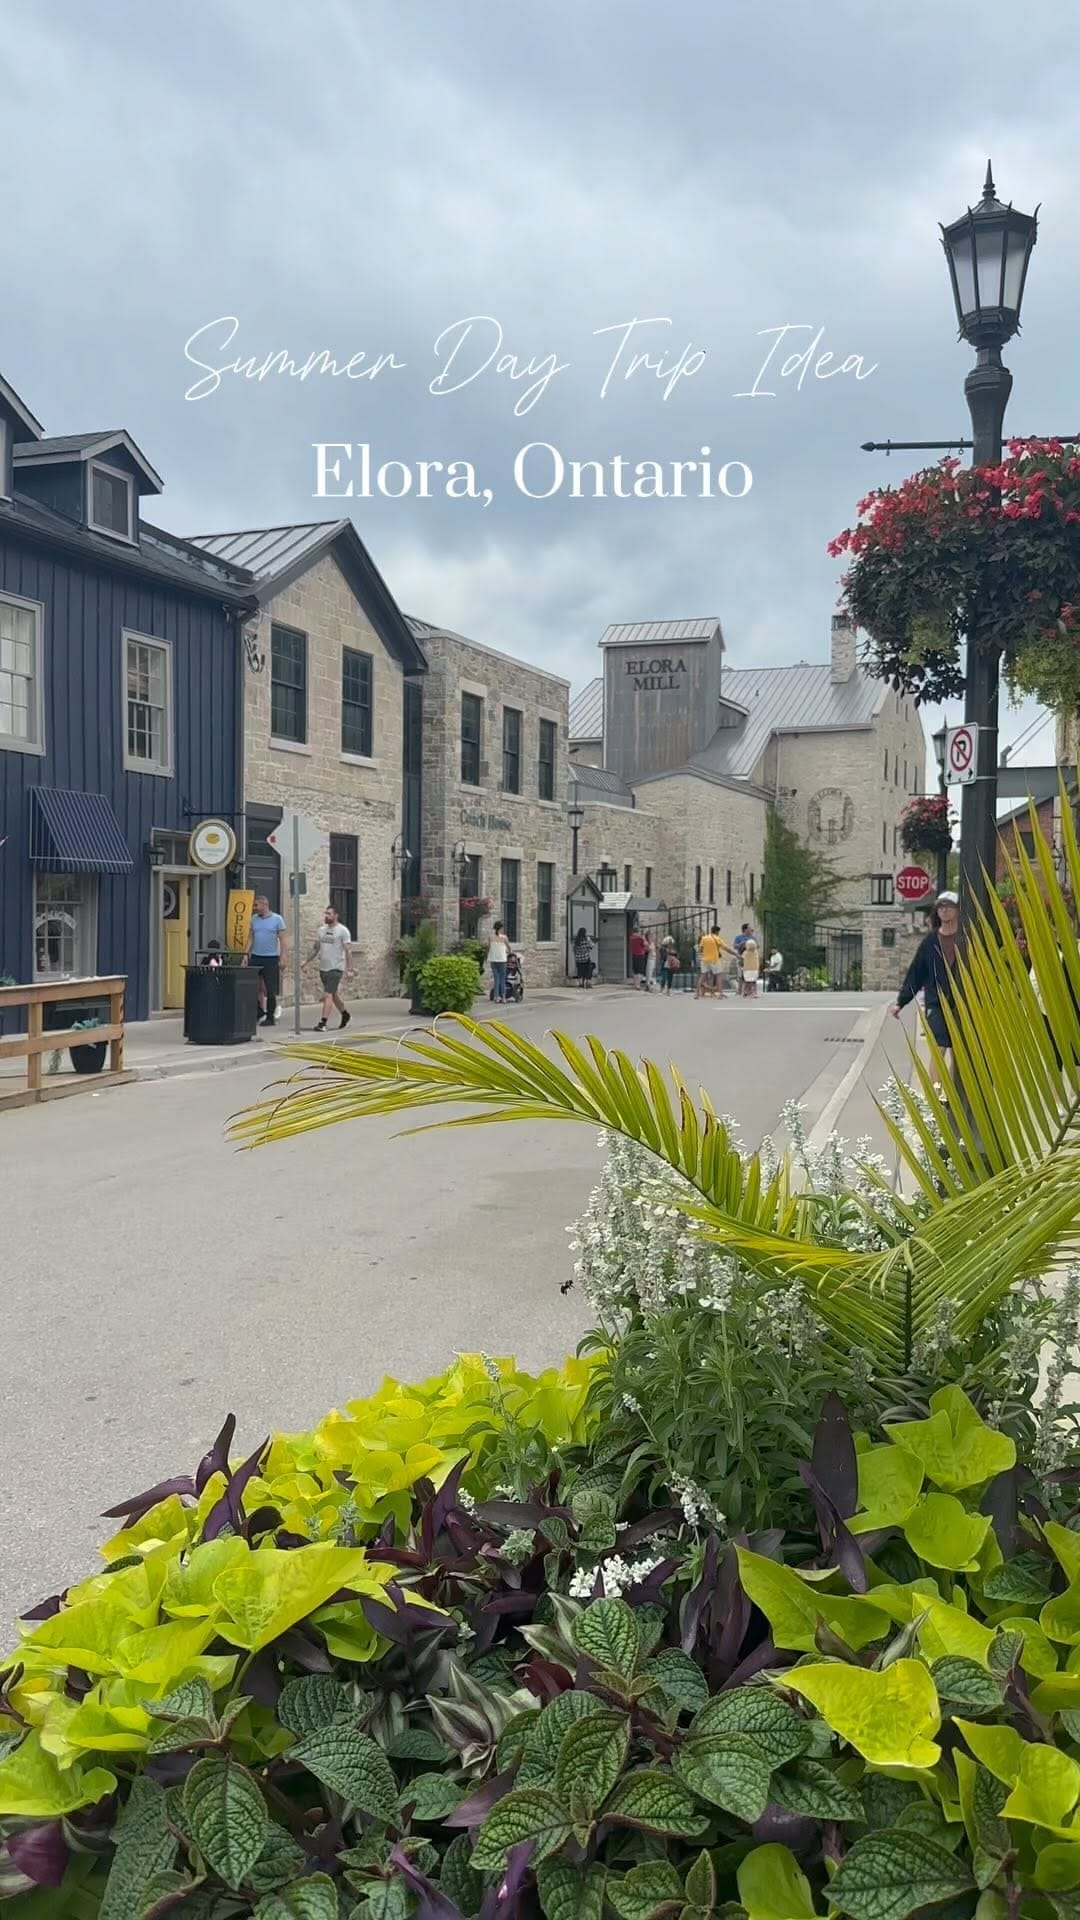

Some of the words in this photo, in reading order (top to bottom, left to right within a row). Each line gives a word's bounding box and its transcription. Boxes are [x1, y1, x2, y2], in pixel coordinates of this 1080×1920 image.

[625, 658, 687, 675] ELORA
[633, 676, 680, 691] MILL
[897, 875, 928, 890] STOP
[233, 900, 247, 948] OPEN
